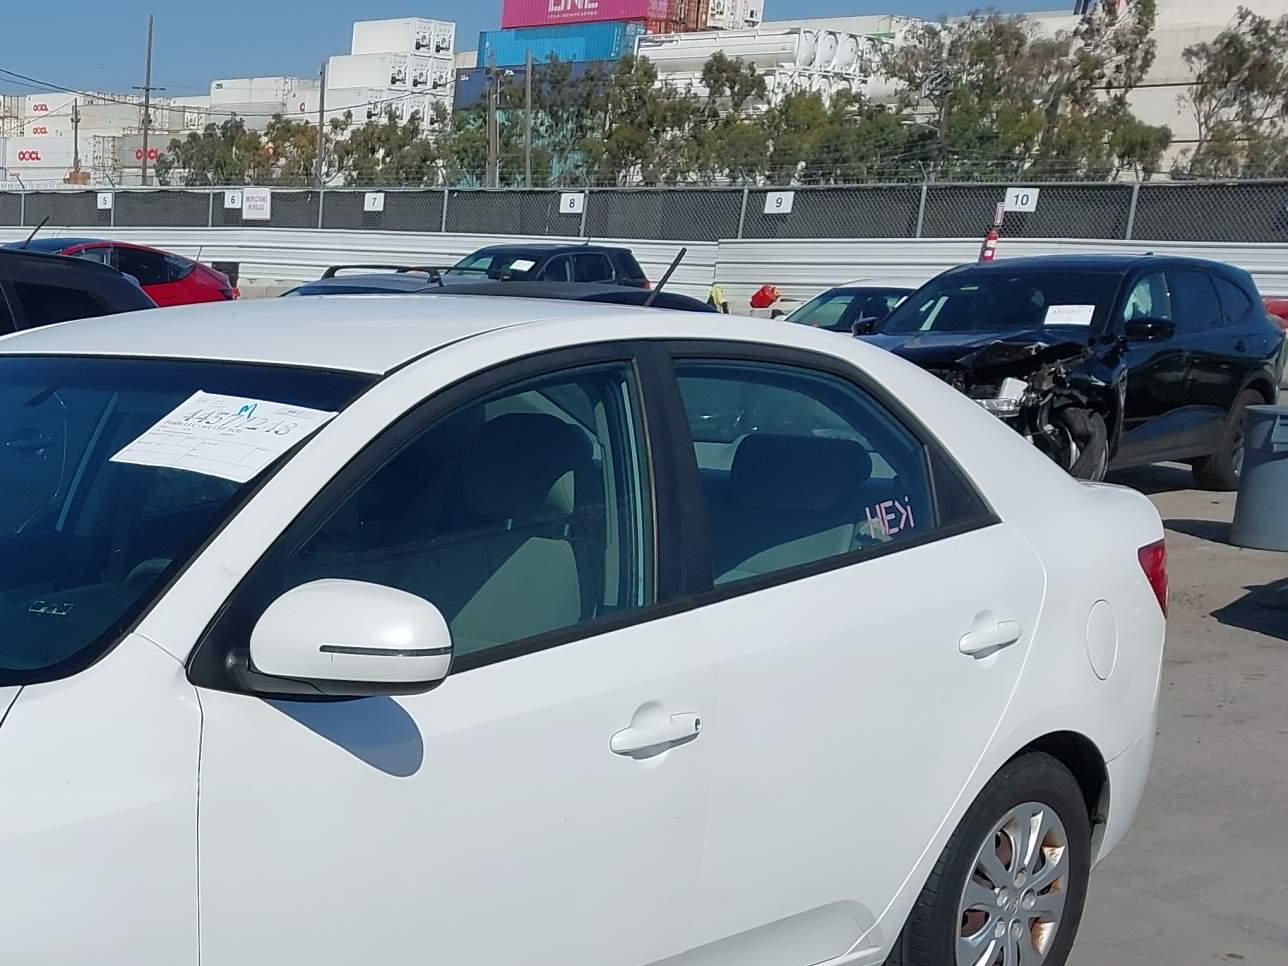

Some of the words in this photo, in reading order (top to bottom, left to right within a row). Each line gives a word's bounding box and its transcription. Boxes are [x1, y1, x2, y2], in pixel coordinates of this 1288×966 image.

[18, 150, 41, 162] OOCL
[102, 196, 108, 205] 5
[230, 195, 236, 204] 6
[371, 197, 377, 207] 7
[569, 198, 575, 208] 8
[775, 197, 783, 208] 9
[1014, 193, 1029, 206] 10
